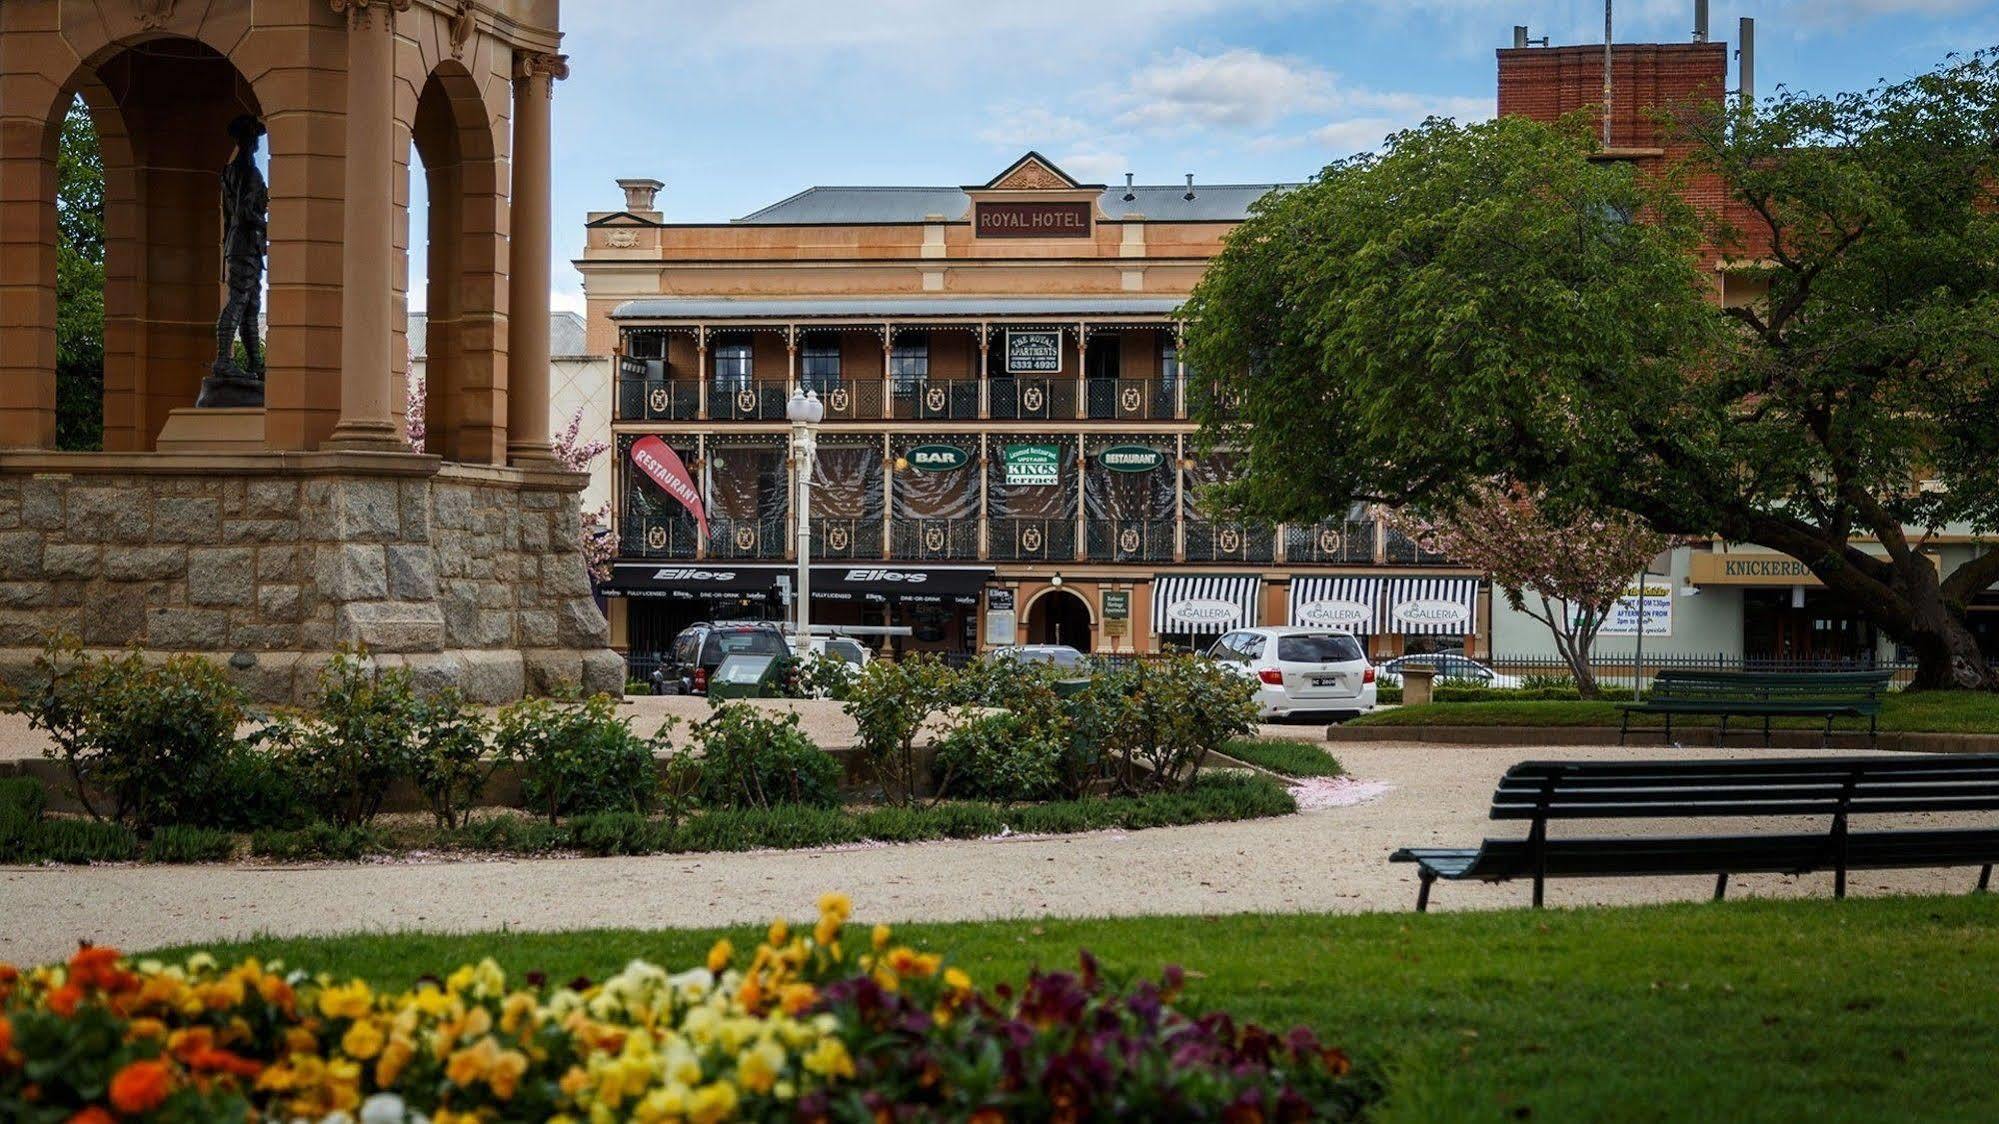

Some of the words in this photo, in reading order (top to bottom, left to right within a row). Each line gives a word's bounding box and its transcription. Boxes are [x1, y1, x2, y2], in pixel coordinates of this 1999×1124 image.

[981, 212, 1029, 227] ROYAL
[1032, 212, 1085, 227] HOTEL
[1012, 336, 1028, 348] THE
[1029, 335, 1054, 348] ROYAL
[1010, 347, 1057, 356] APARTMENTS
[915, 452, 956, 463] BAR
[1105, 453, 1156, 464] RESTAURANT
[1008, 465, 1057, 475] KINGS
[635, 449, 699, 504] RESTAURANT
[1007, 476, 1057, 484] terrace
[1726, 561, 1811, 576] KNICKERBO
